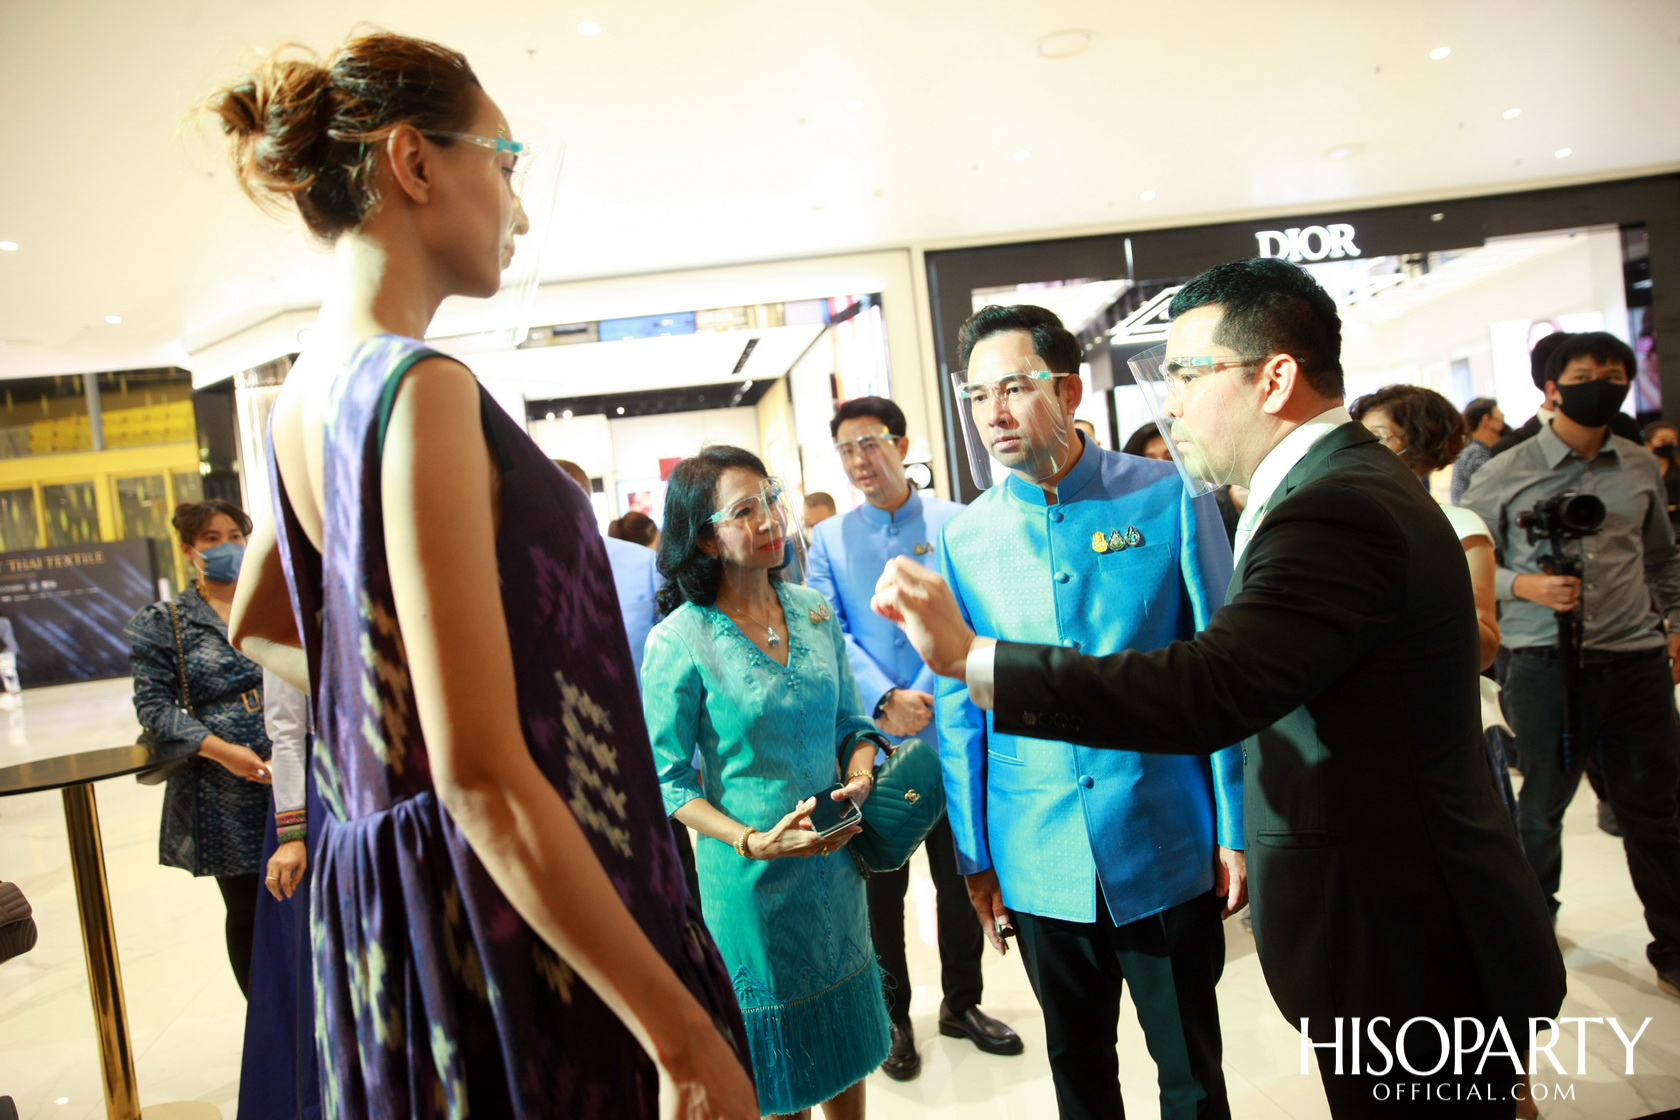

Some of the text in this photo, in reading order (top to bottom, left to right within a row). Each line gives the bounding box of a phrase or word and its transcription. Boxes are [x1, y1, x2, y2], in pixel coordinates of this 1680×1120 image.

[1254, 223, 1362, 262] DIOR
[8, 558, 43, 571] THAI
[45, 551, 104, 568] TEXTILE
